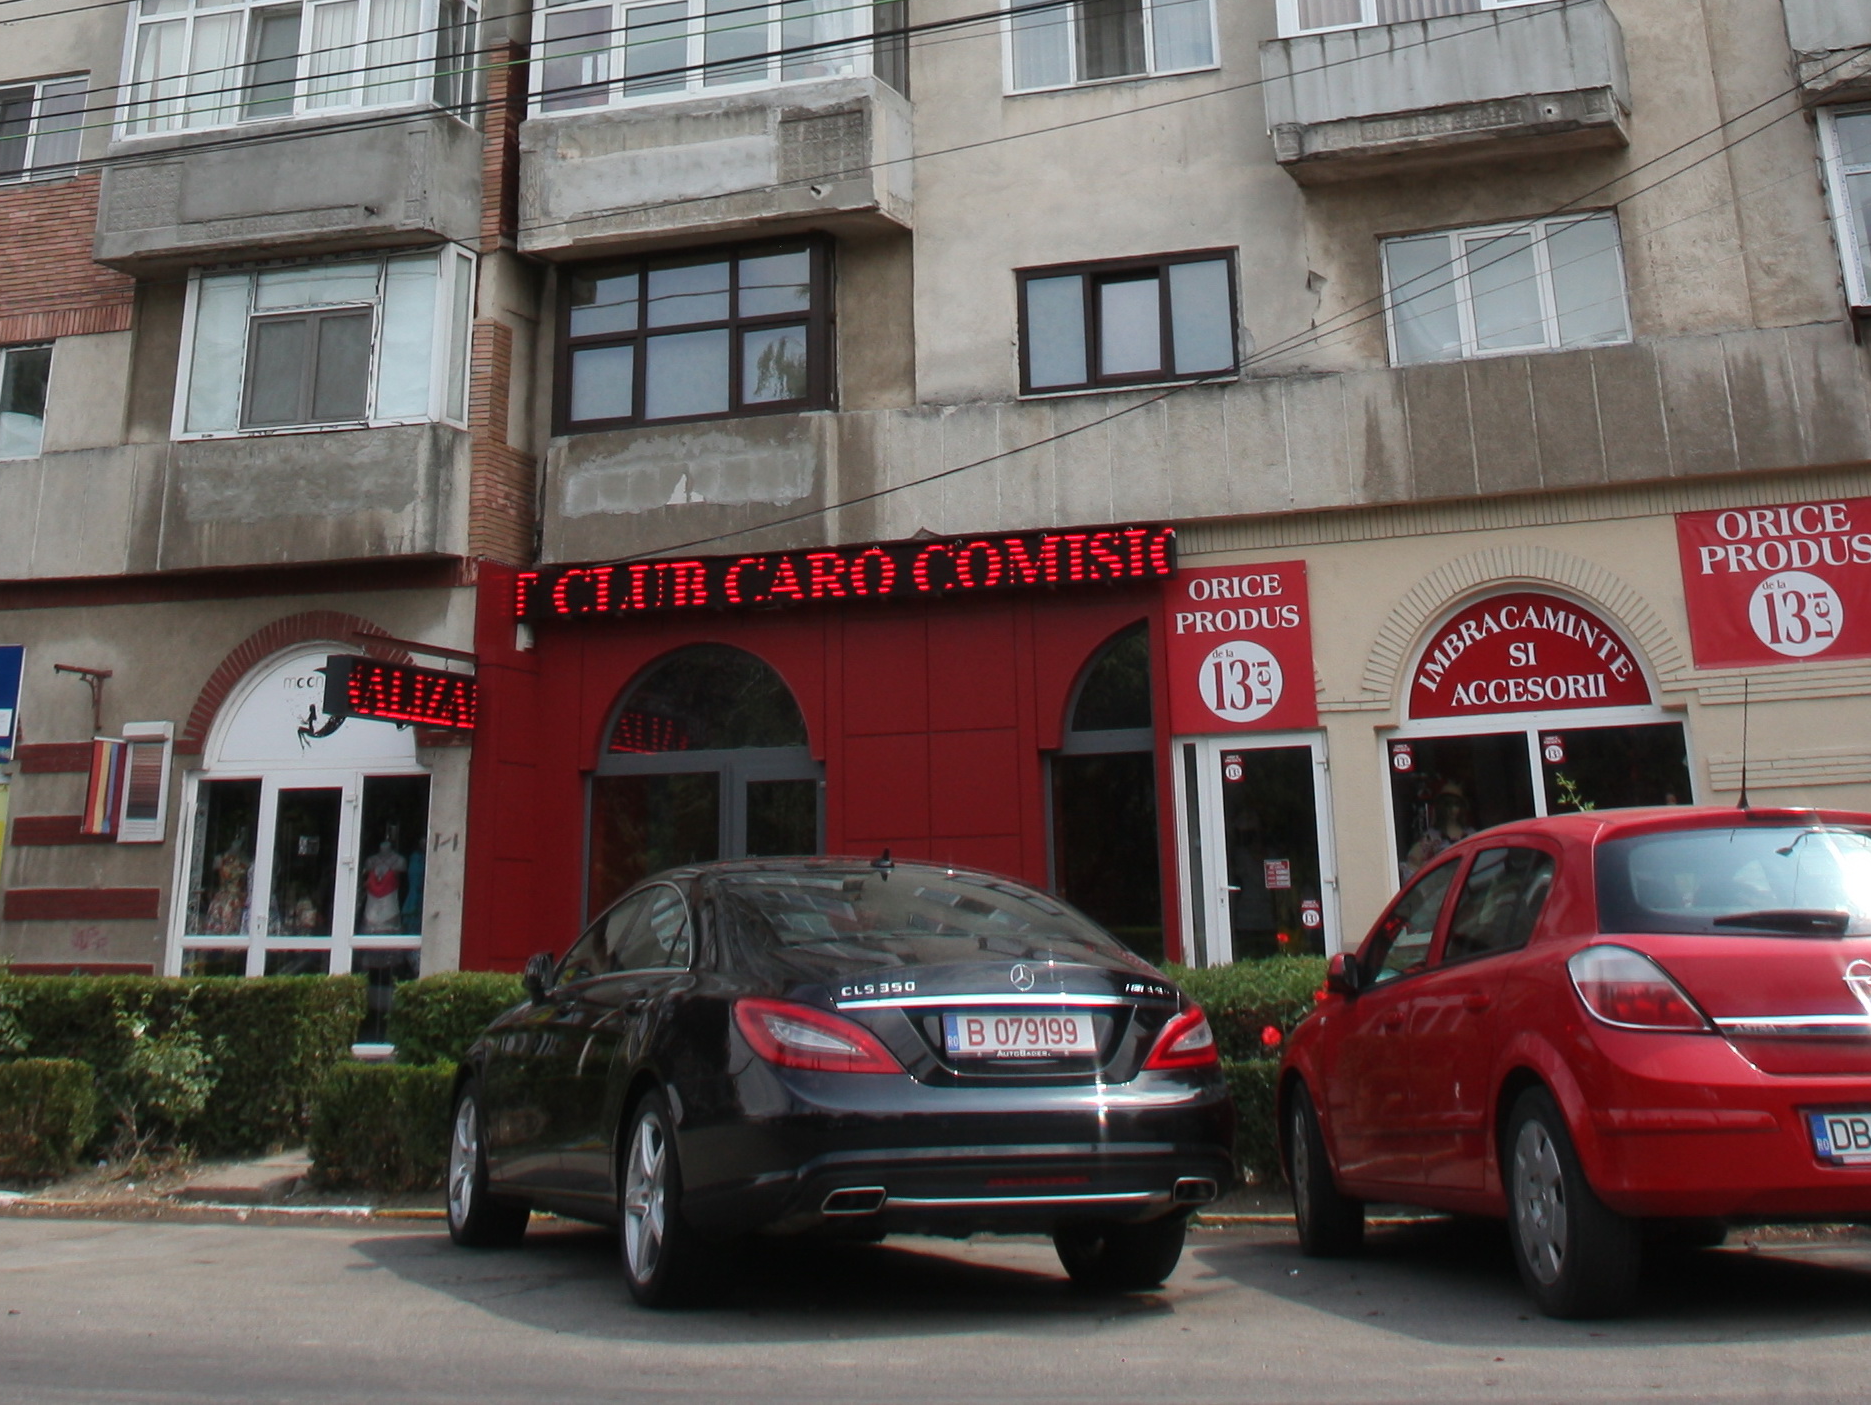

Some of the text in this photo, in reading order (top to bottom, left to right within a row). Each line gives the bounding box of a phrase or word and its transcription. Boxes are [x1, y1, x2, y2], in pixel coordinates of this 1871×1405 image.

[1715, 502, 1852, 541] ORICE
[552, 560, 708, 614] CLUB
[725, 548, 897, 604] CARO
[1187, 573, 1283, 602] ORICE
[1762, 579, 1787, 590] de la
[1175, 604, 1301, 635] PRODUS
[1762, 589, 1834, 645] 13 Lei
[1212, 649, 1234, 659] de la
[1417, 605, 1635, 694] IMBRACAMINTE
[1507, 642, 1538, 668] SI
[1212, 659, 1273, 711] 13 Lei
[1449, 673, 1609, 707] ACCESORII
[841, 980, 916, 997] CLS 350
[966, 1017, 986, 1046] B
[994, 1016, 1079, 1046] 079199
